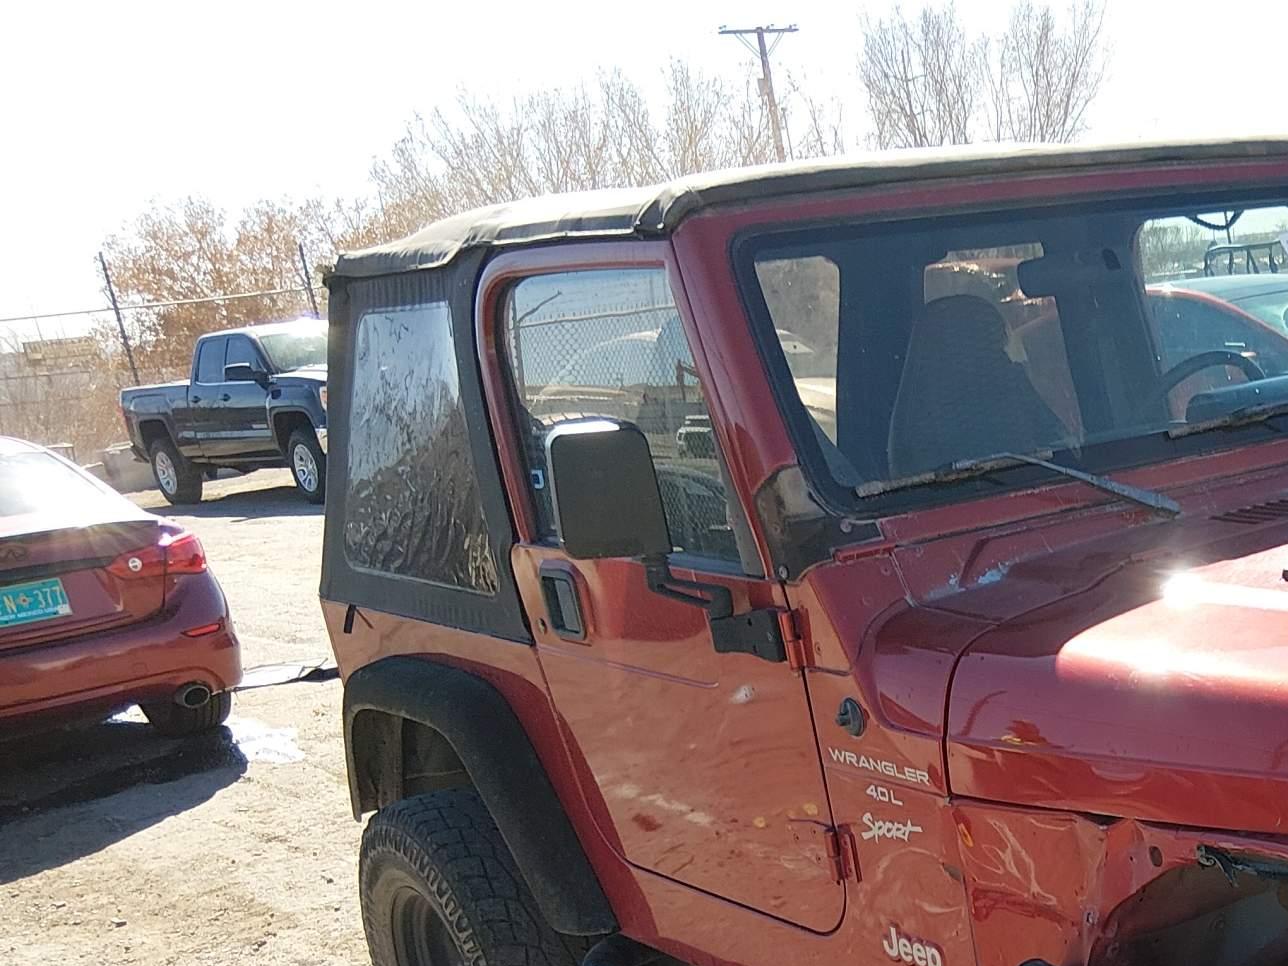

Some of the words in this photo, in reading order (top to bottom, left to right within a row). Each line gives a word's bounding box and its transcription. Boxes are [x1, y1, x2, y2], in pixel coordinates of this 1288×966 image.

[0, 594, 18, 615] N
[33, 586, 63, 609] 377
[828, 747, 930, 785] WRANGLER
[861, 812, 923, 844] Sport
